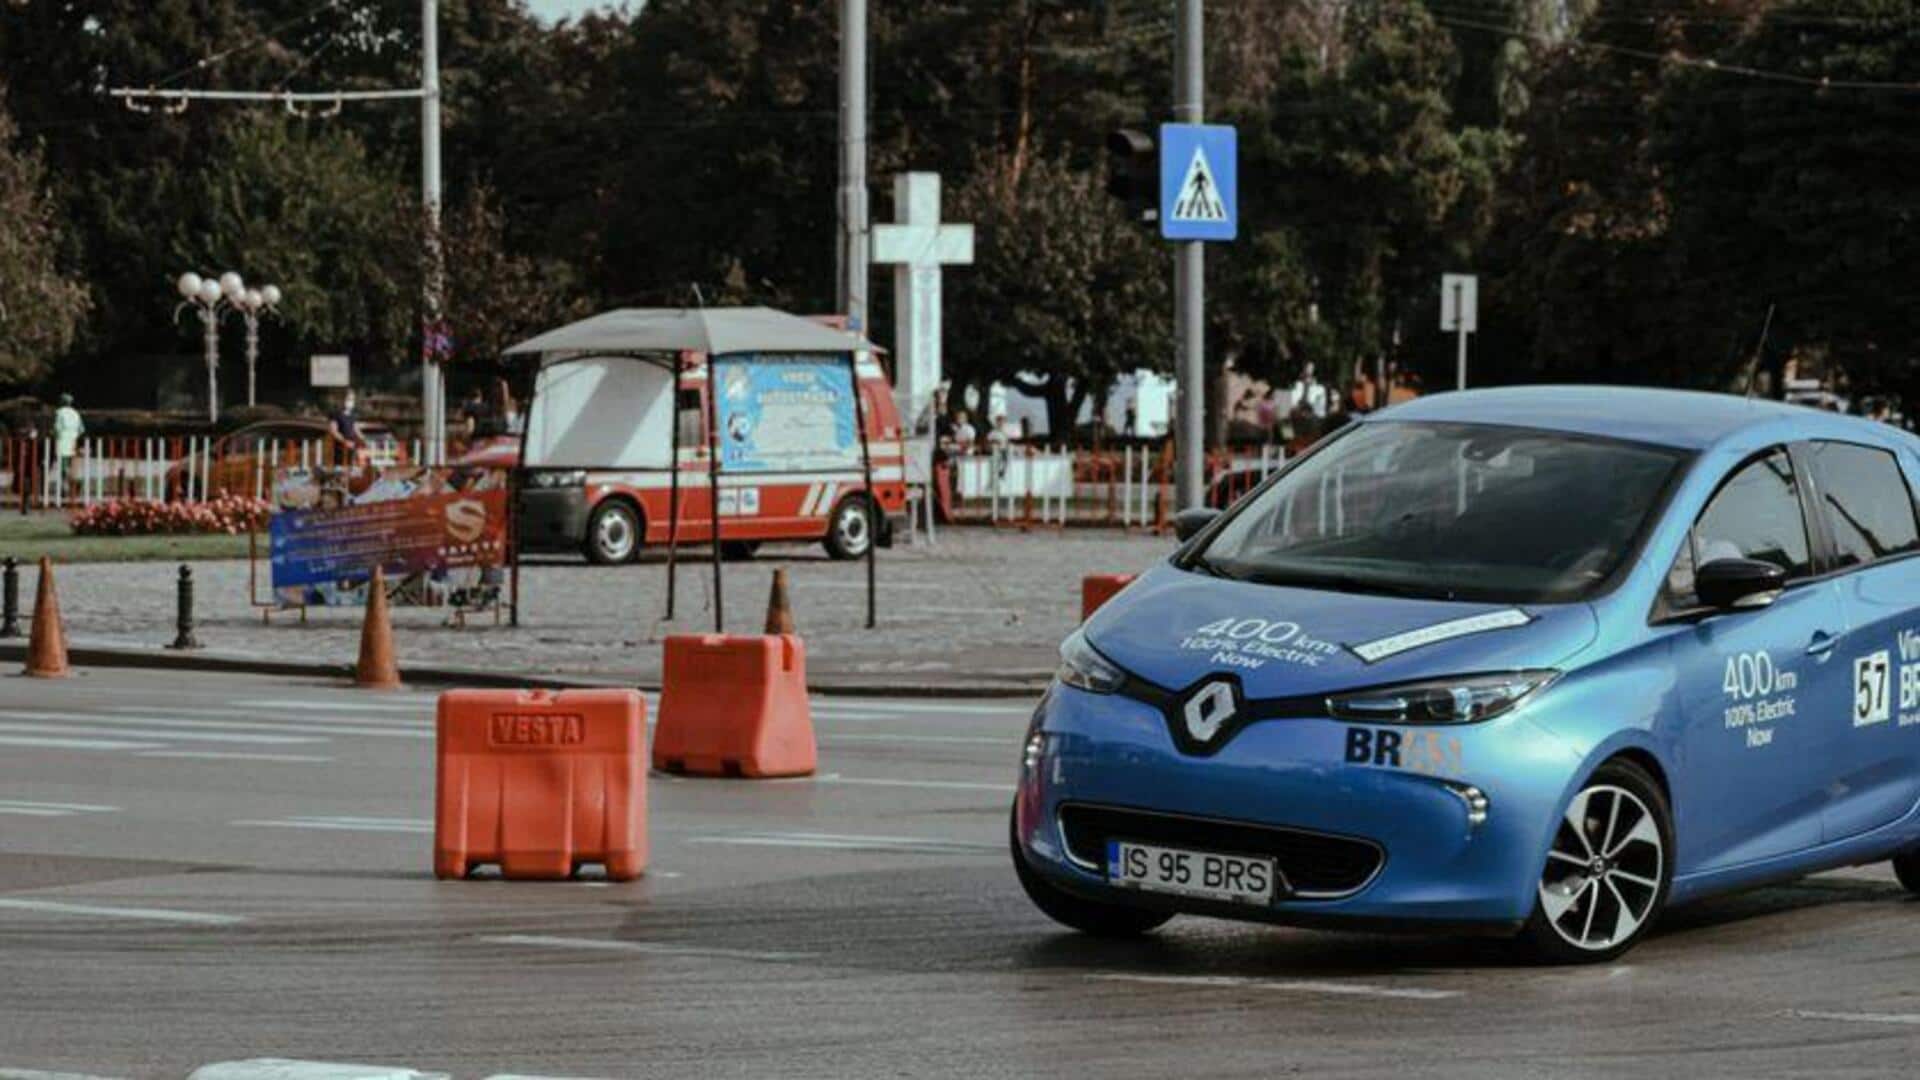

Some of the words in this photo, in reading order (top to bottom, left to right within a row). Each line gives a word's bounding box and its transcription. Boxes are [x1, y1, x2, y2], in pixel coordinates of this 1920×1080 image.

[1197, 618, 1300, 642] 400
[1181, 637, 1237, 650] 100%
[1241, 640, 1323, 667] Electric
[1210, 651, 1264, 669] Now
[1723, 651, 1772, 699] 400
[1775, 668, 1797, 692] km
[1858, 660, 1886, 718] 57
[1725, 704, 1755, 728] 100%
[1757, 696, 1795, 721] Electric
[498, 715, 580, 744] VESTA
[1747, 727, 1774, 748] Now
[1124, 847, 1148, 879] IS
[1159, 852, 1191, 884] 95
[1204, 857, 1268, 893] BRS
